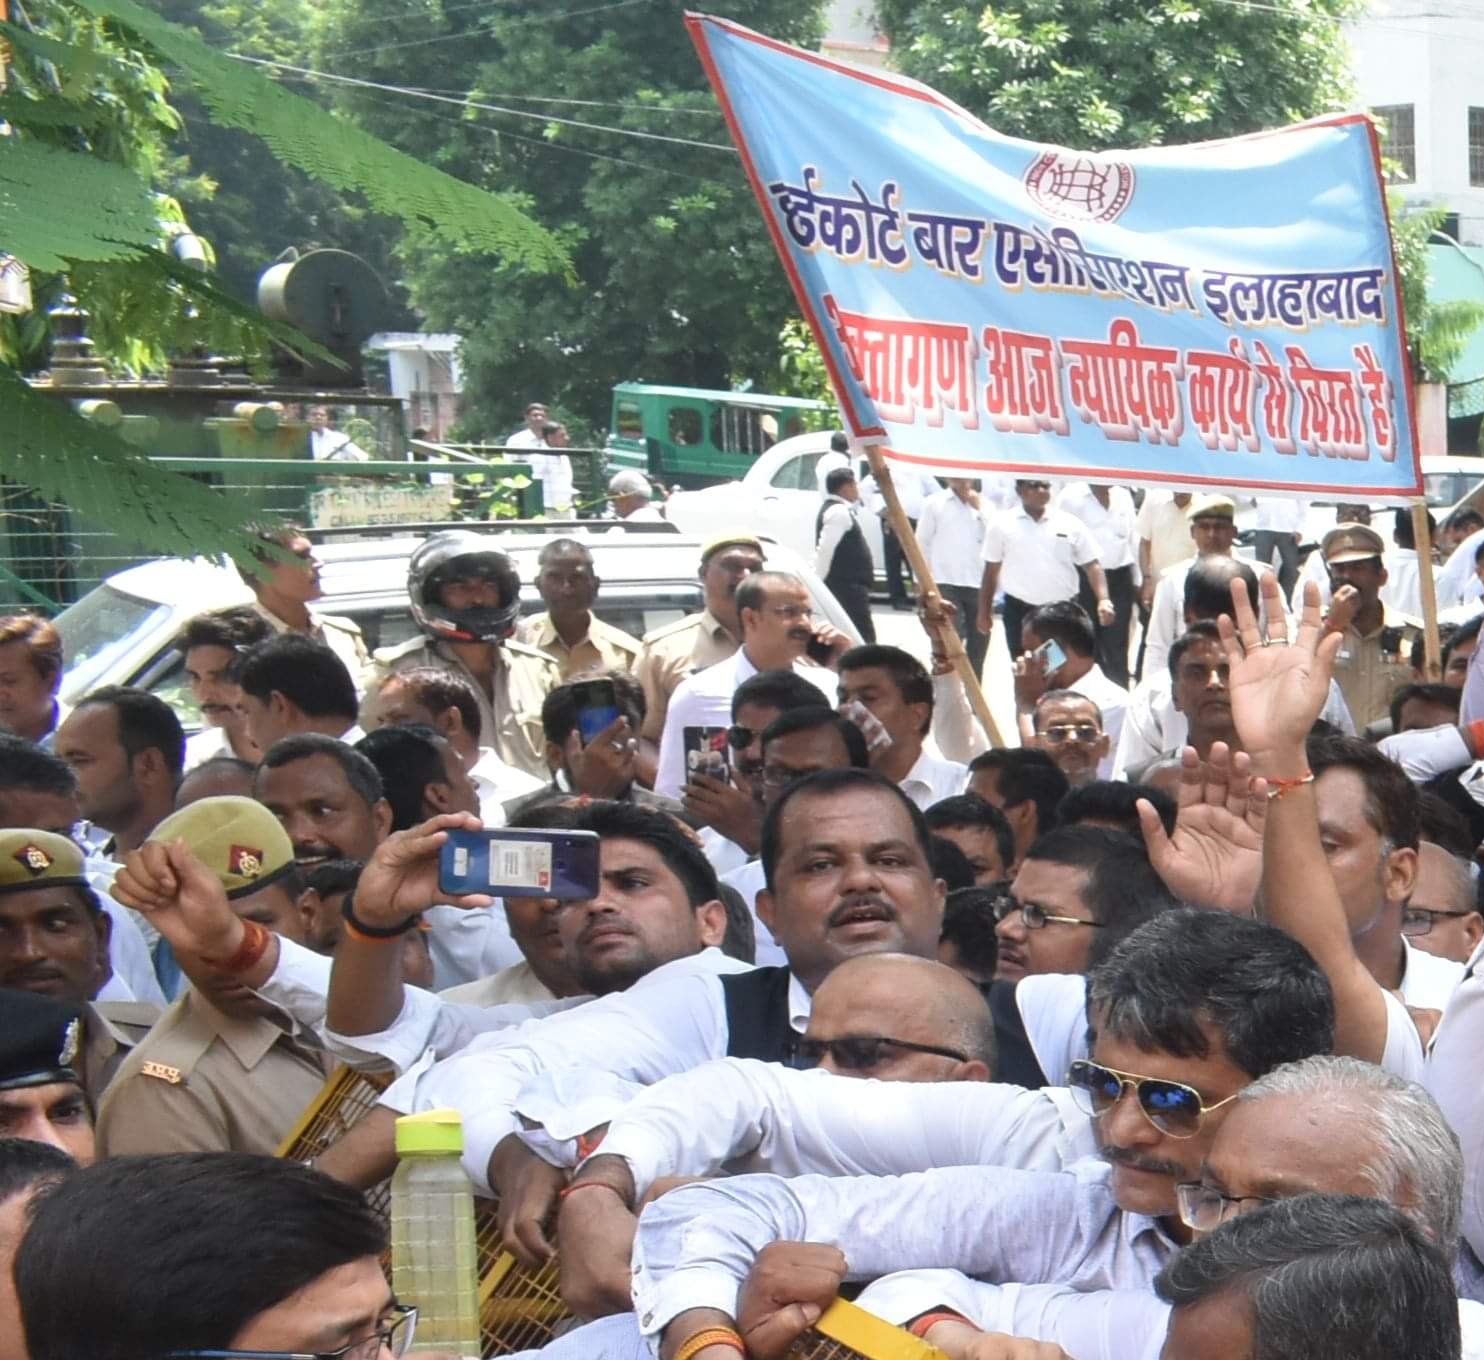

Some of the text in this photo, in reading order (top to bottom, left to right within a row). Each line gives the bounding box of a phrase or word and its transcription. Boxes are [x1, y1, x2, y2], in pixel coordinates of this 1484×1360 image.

[907, 211, 986, 278] बार
[1201, 268, 1385, 327] इलाहाबाद
[983, 326, 1062, 422] आज
[1060, 318, 1179, 434] न्यायिक
[1186, 337, 1254, 440] कार्य
[1253, 340, 1290, 443] से
[1284, 346, 1364, 448] विरत
